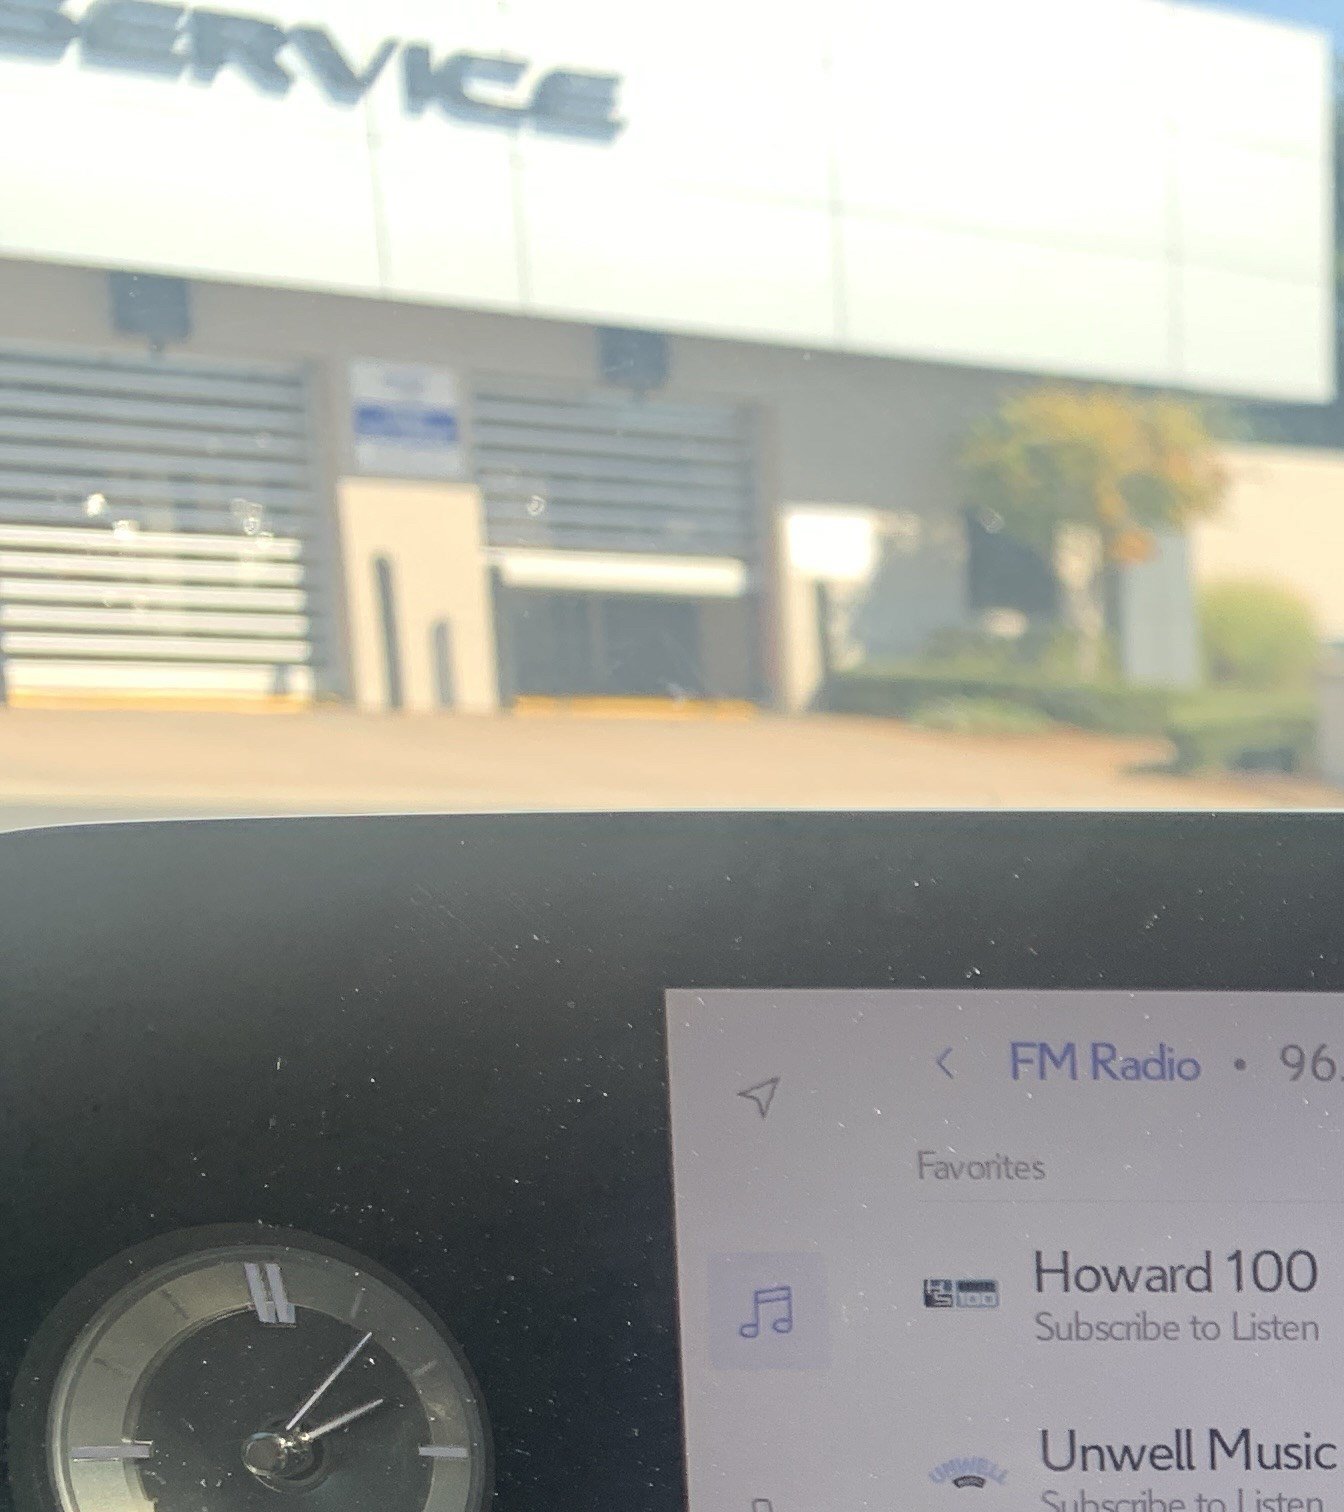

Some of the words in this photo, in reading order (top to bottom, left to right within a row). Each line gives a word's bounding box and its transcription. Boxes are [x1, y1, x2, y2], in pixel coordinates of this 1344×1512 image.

[0, 0, 625, 147] SERVICE
[1010, 1041, 1078, 1081] FM
[1090, 1041, 1201, 1082] Radio
[916, 1149, 1047, 1182] Favorites
[1033, 1249, 1213, 1294] Howard
[1227, 1249, 1318, 1294] 100
[1034, 1311, 1181, 1343] Subscribe
[1189, 1314, 1222, 1343] to
[1232, 1311, 1320, 1343] Listen
[1040, 1428, 1196, 1472] Unwell
[1208, 1428, 1338, 1472] Music
